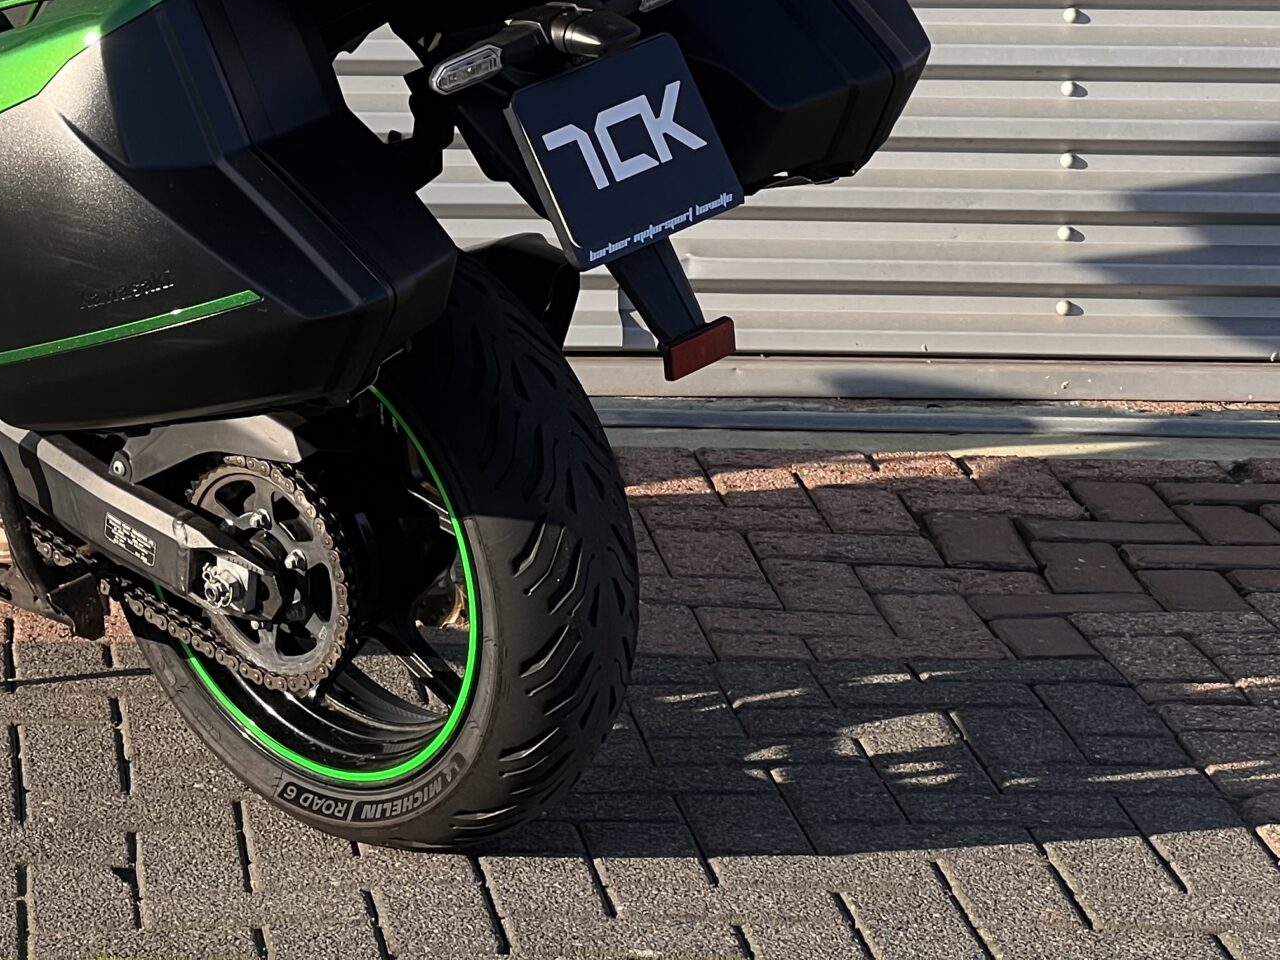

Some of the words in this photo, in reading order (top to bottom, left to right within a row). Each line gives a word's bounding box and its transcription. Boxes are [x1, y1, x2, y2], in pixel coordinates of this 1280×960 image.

[541, 80, 708, 190] TCK
[633, 207, 693, 244] motorsport
[283, 785, 297, 800] 6
[299, 793, 348, 818] ROAD
[360, 780, 443, 820] MICHELIN
